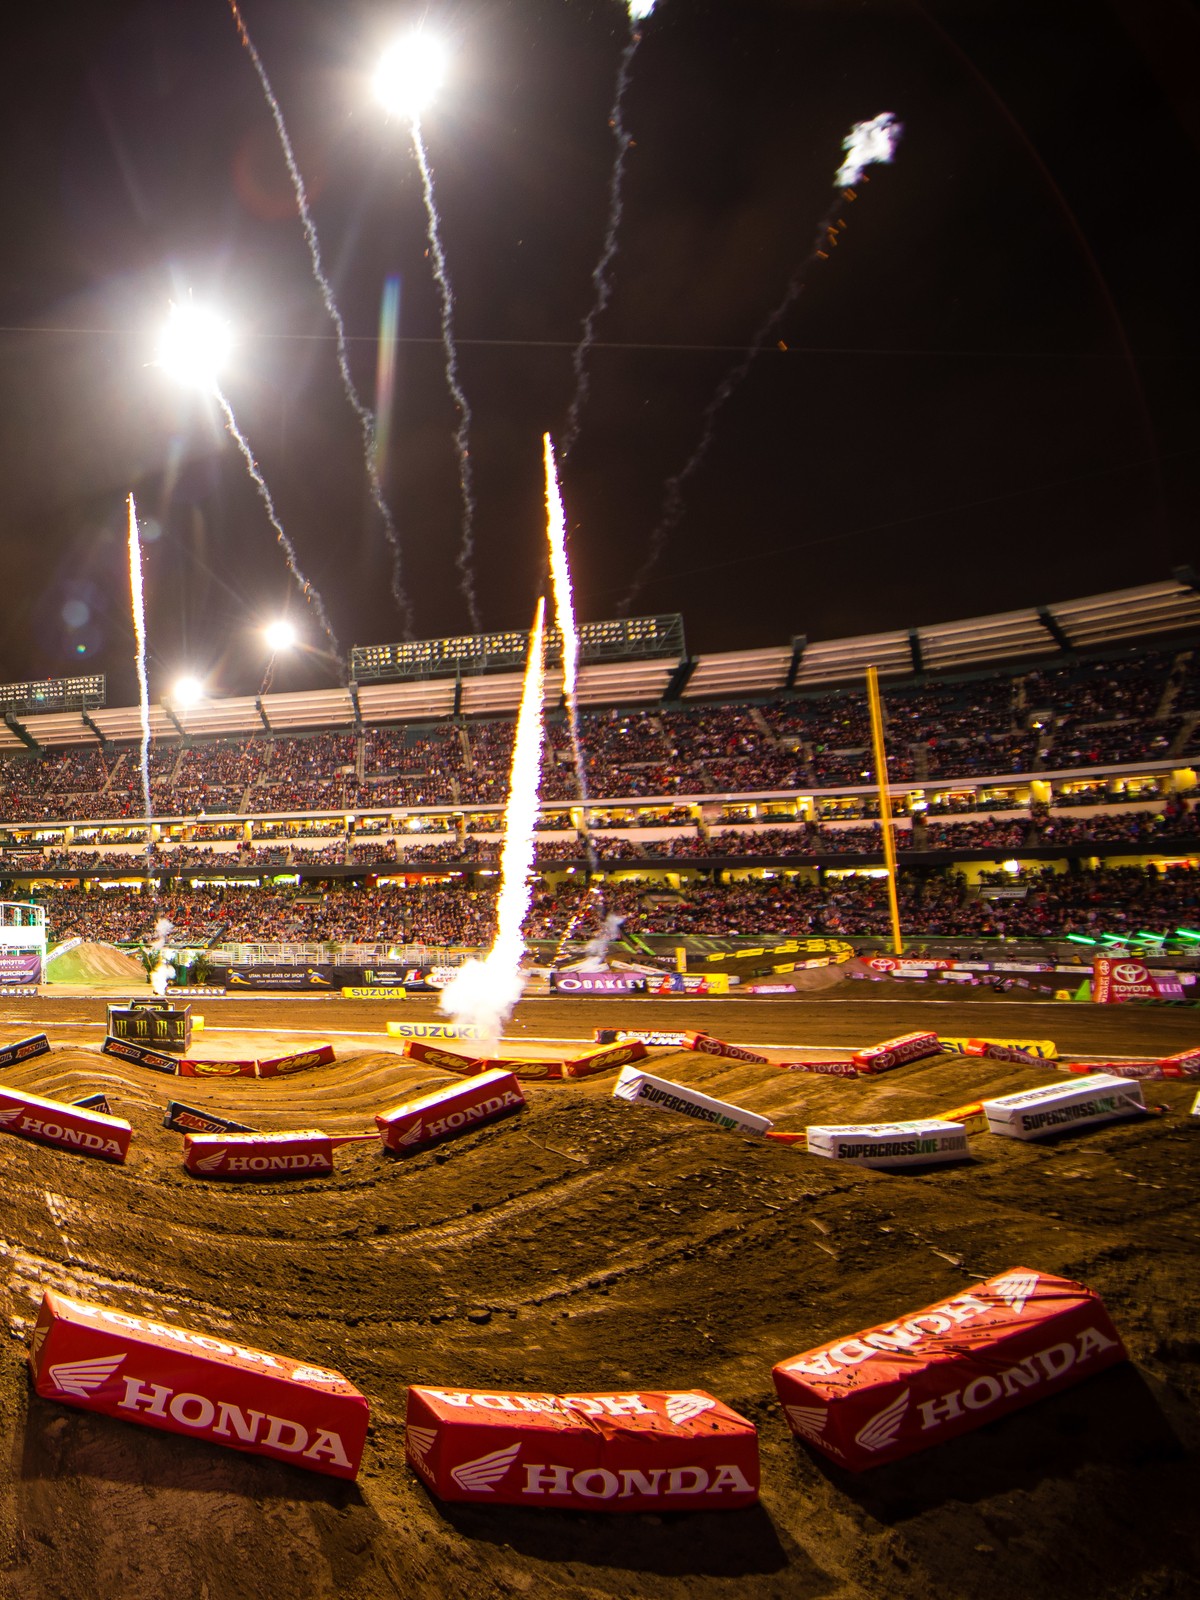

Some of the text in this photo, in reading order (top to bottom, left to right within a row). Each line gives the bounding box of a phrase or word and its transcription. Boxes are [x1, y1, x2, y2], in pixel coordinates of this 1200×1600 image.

[352, 988, 400, 997] SUZUKI
[584, 979, 645, 989] OAKLEY
[1112, 985, 1155, 993] TOYOTA
[400, 1025, 479, 1038] SUZUKI
[16, 1038, 48, 1059] AMSOIL
[107, 1042, 142, 1059] AMSOIL
[724, 1046, 766, 1064] TOYOTA
[894, 1035, 937, 1055] TOYOTA
[811, 1064, 856, 1074] TOYOTA
[173, 1111, 227, 1134] AMSOIL
[425, 1090, 523, 1137] HONDA
[20, 1115, 123, 1156] HONDA
[227, 1152, 330, 1171] HONDA
[55, 1295, 284, 1369] HONDA
[785, 1293, 995, 1376] HONDA
[917, 1326, 1119, 1431] HONDA
[117, 1375, 353, 1468] HONDA
[522, 1464, 756, 1499] HONDA
